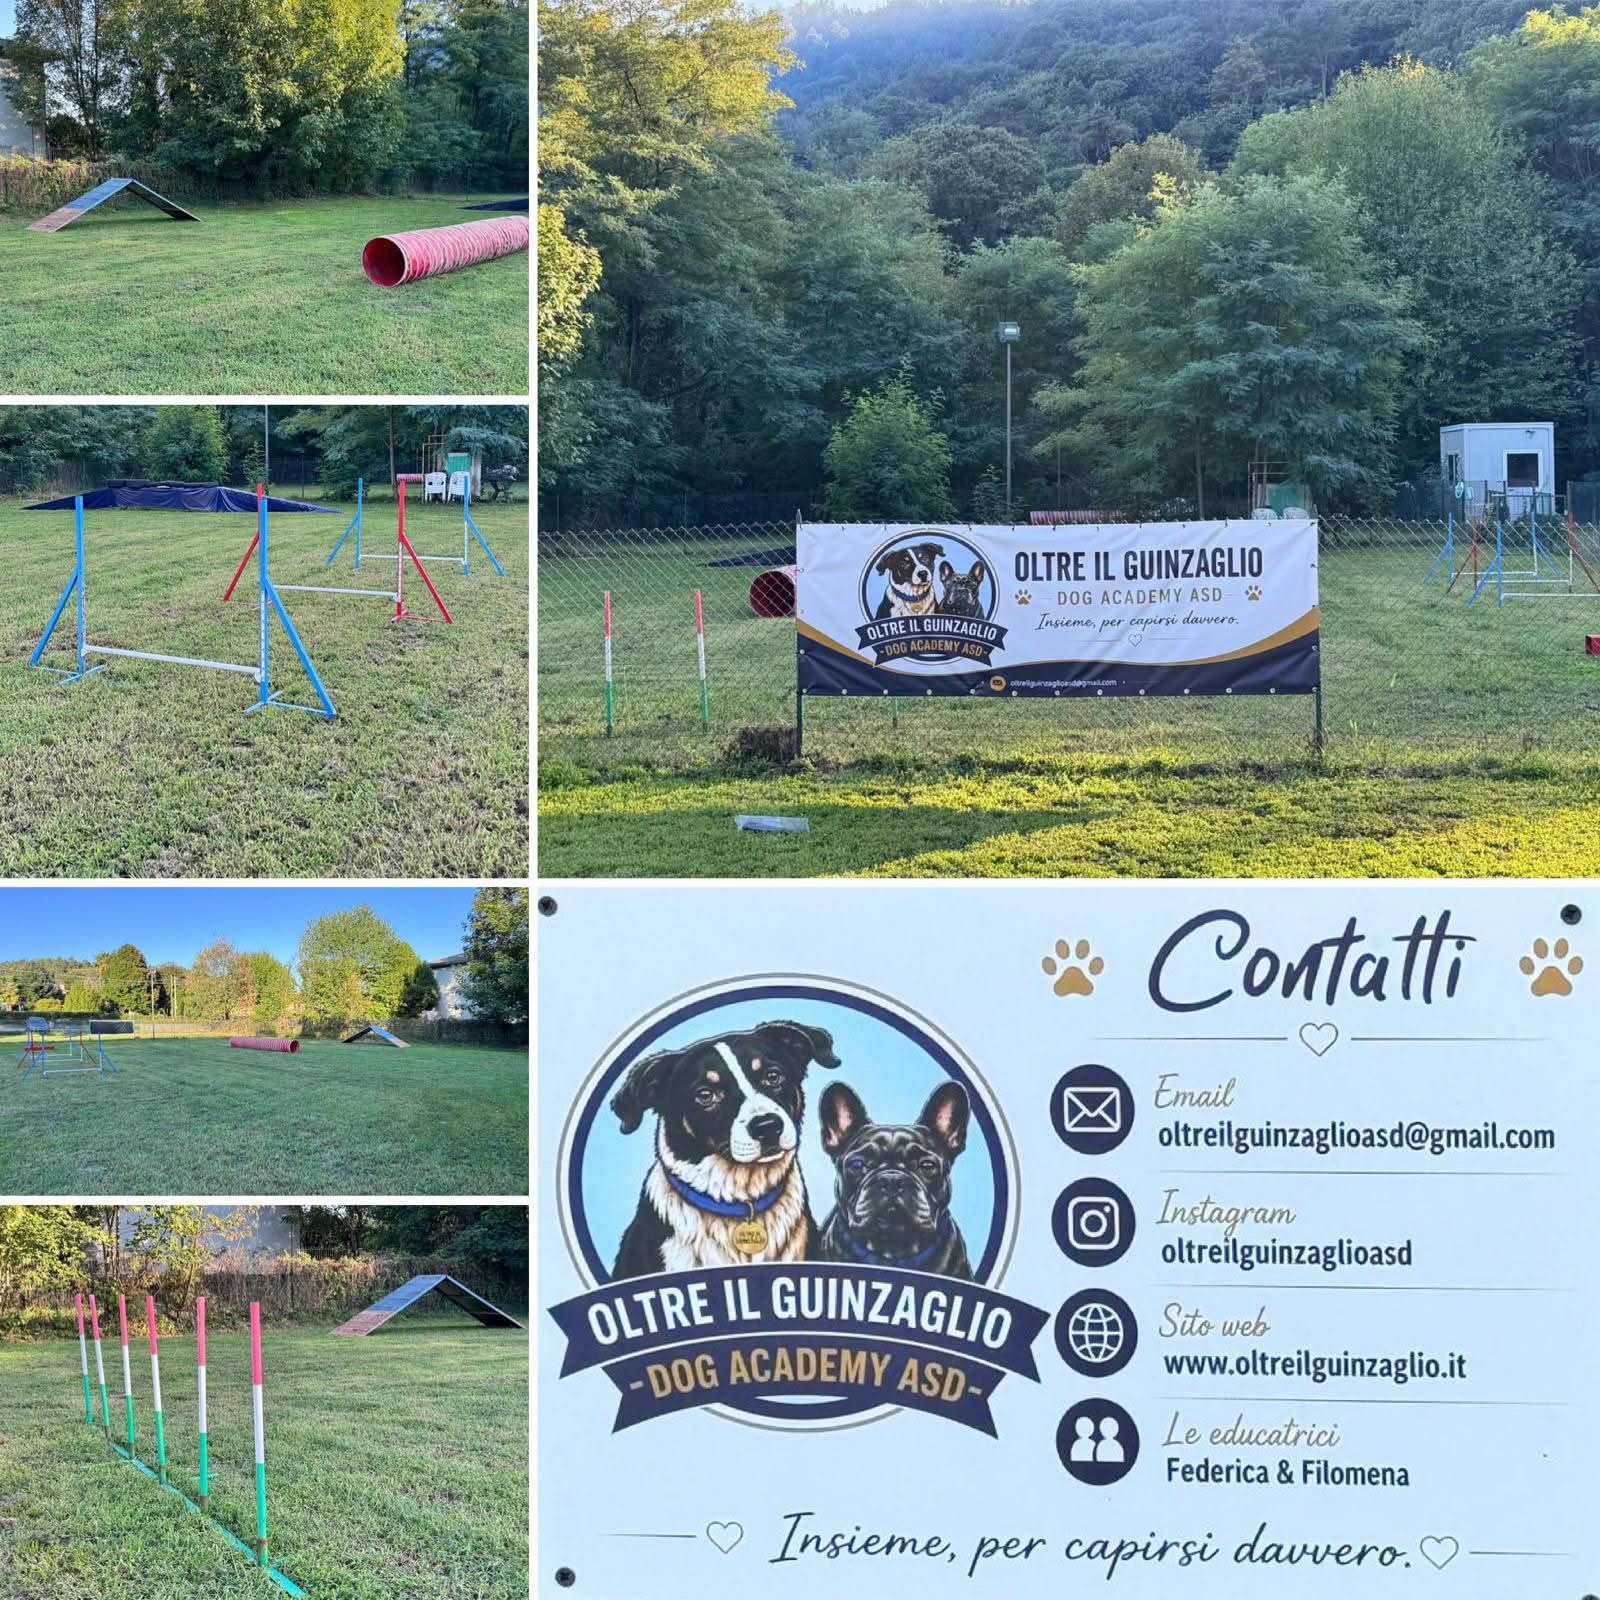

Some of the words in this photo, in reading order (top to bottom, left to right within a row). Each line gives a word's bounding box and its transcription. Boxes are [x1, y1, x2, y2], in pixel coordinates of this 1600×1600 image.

[1015, 551, 1086, 582] OLTRE
[1094, 551, 1116, 581] IL
[1123, 547, 1263, 581] GUINZAGLIO
[1057, 590, 1093, 606] DOG
[1100, 588, 1182, 605] ACADEMY
[1189, 587, 1223, 602] ASD
[867, 621, 907, 641] OLTRE
[909, 619, 921, 633] IL
[923, 618, 997, 641] GUINZAGLIO
[1035, 612, 1097, 631] Insieme,
[1098, 618, 1125, 633] per
[1129, 614, 1179, 632] capirsi
[1182, 610, 1240, 625] davvero.
[910, 639, 960, 652] ACADEMY
[1148, 909, 1477, 1013] Contatti
[1153, 1073, 1237, 1110] Email
[1158, 1119, 1556, 1155] oltreilguinzaglioasd@gmail.com
[1156, 1189, 1296, 1236] Instagram
[1161, 1237, 1413, 1271] oltreilguinzaglioasd
[587, 1284, 713, 1346] OLTRE
[723, 1278, 761, 1322] IL
[771, 1277, 1012, 1349] GUINZAGLIO
[1158, 1302, 1214, 1339] Sito
[1221, 1306, 1271, 1338] web
[729, 1347, 892, 1386] ACADEMY
[1163, 1349, 1467, 1385] www.oltreilguinzaglio.it
[1162, 1411, 1202, 1447] Le
[1209, 1414, 1341, 1448] educatrici
[1166, 1457, 1269, 1485] Federica
[1276, 1460, 1295, 1485] &
[1301, 1460, 1410, 1487] Filomena
[768, 1511, 957, 1564] Insieme,
[967, 1535, 1047, 1578] per
[1064, 1531, 1219, 1580] capirsi
[1233, 1522, 1412, 1570] davvero.
